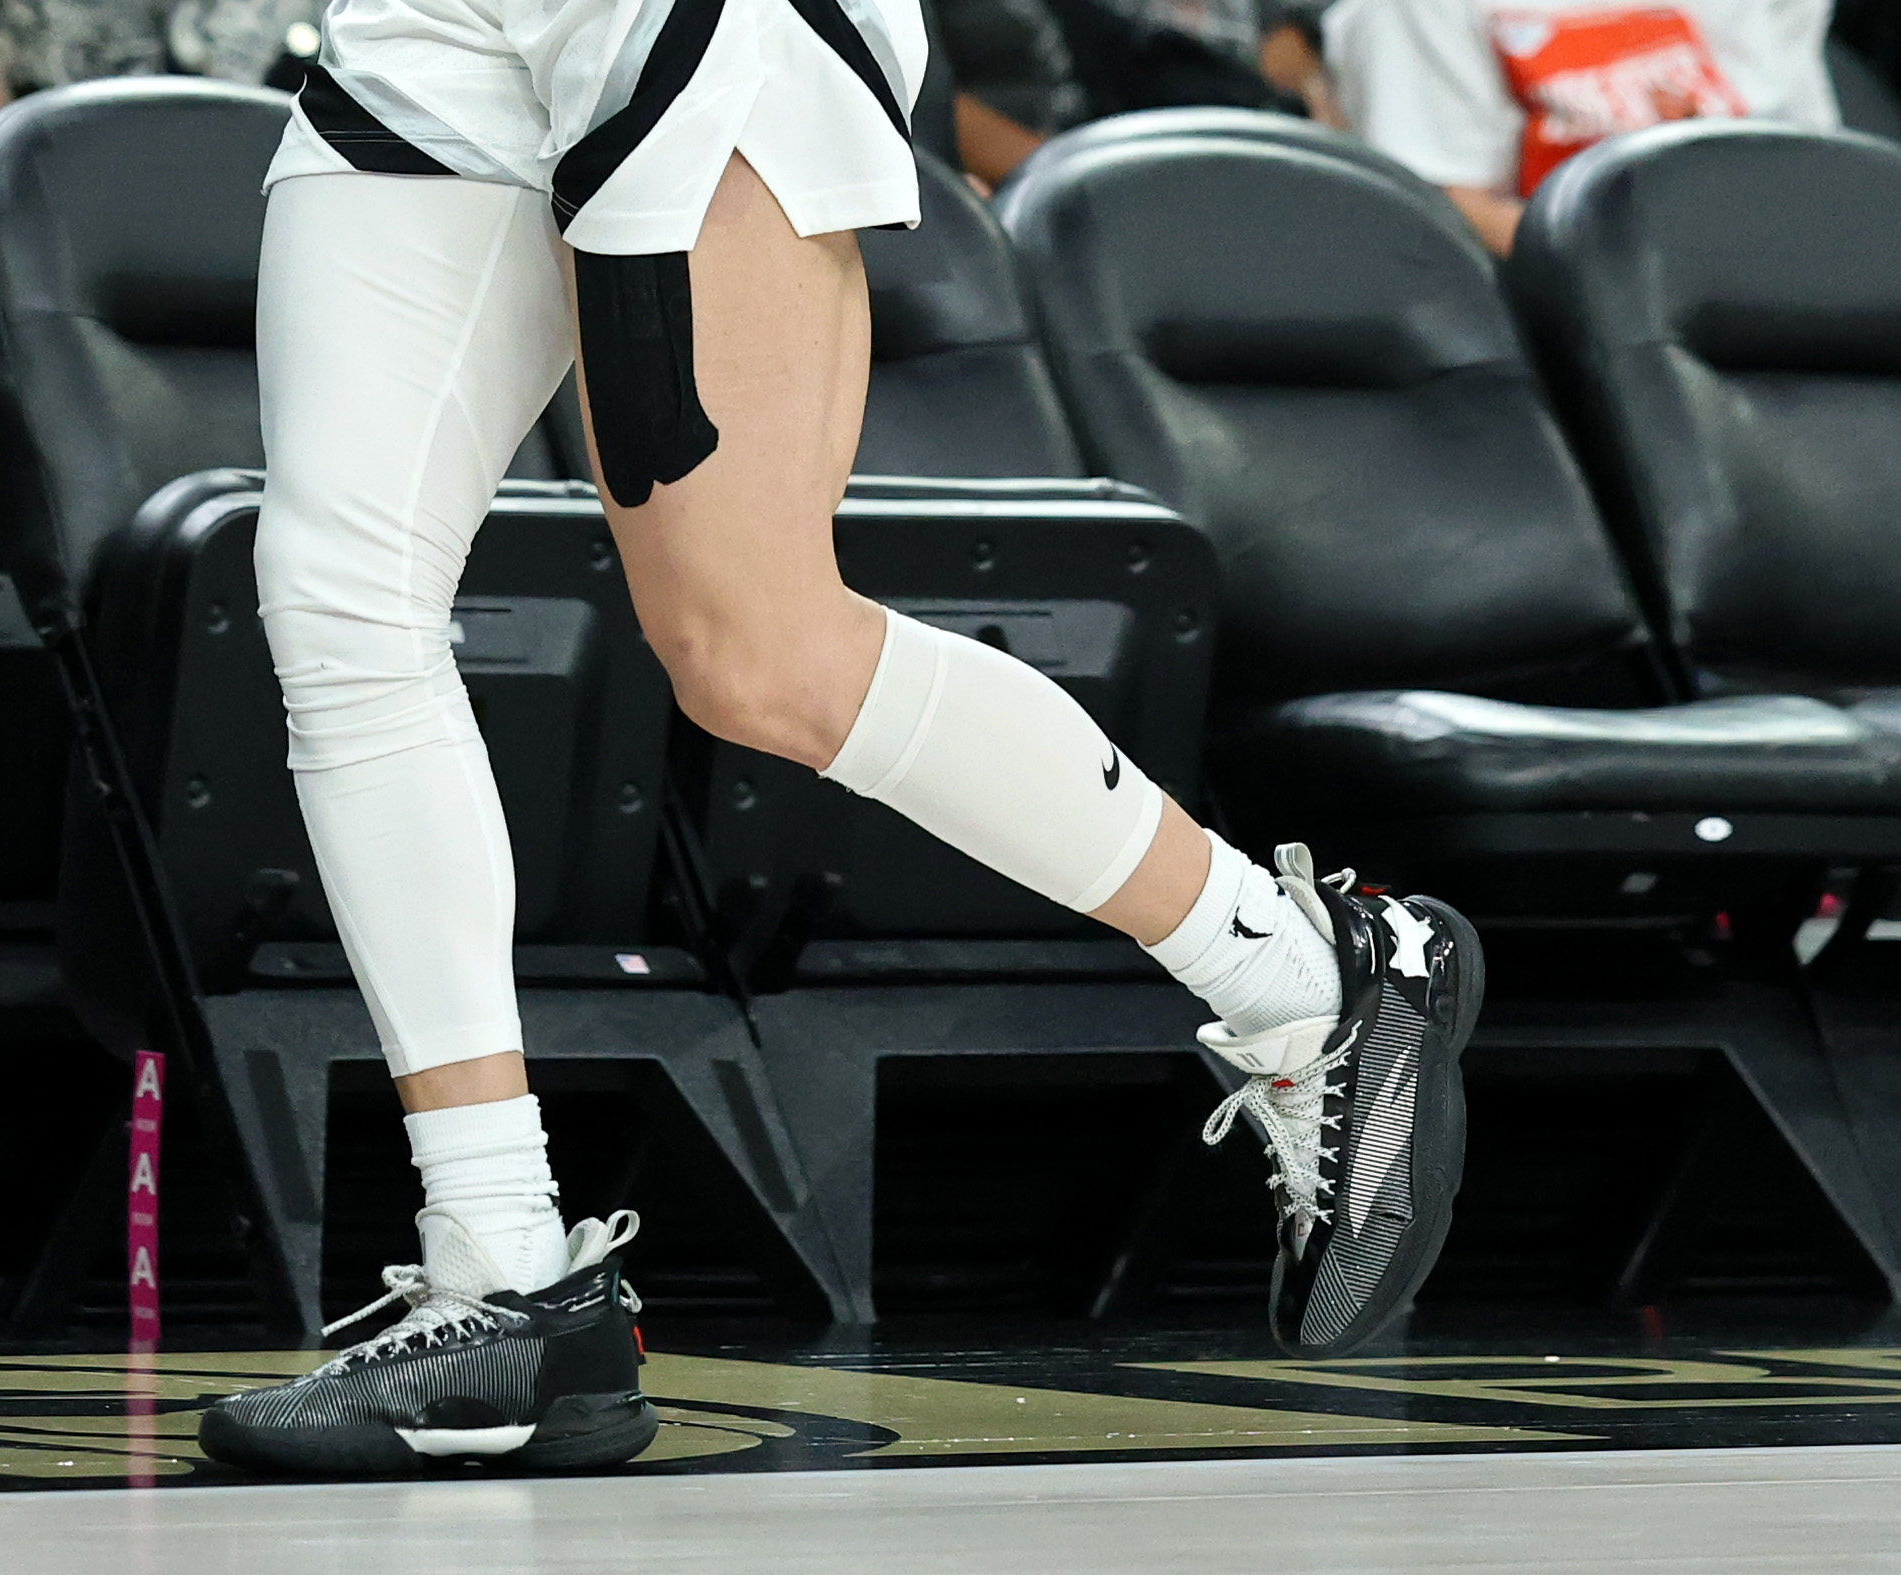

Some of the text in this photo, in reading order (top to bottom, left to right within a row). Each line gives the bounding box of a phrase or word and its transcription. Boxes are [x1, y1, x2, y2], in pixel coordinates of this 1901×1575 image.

[136, 1058, 162, 1100] A
[131, 1152, 156, 1195] A
[131, 1246, 157, 1289] A
